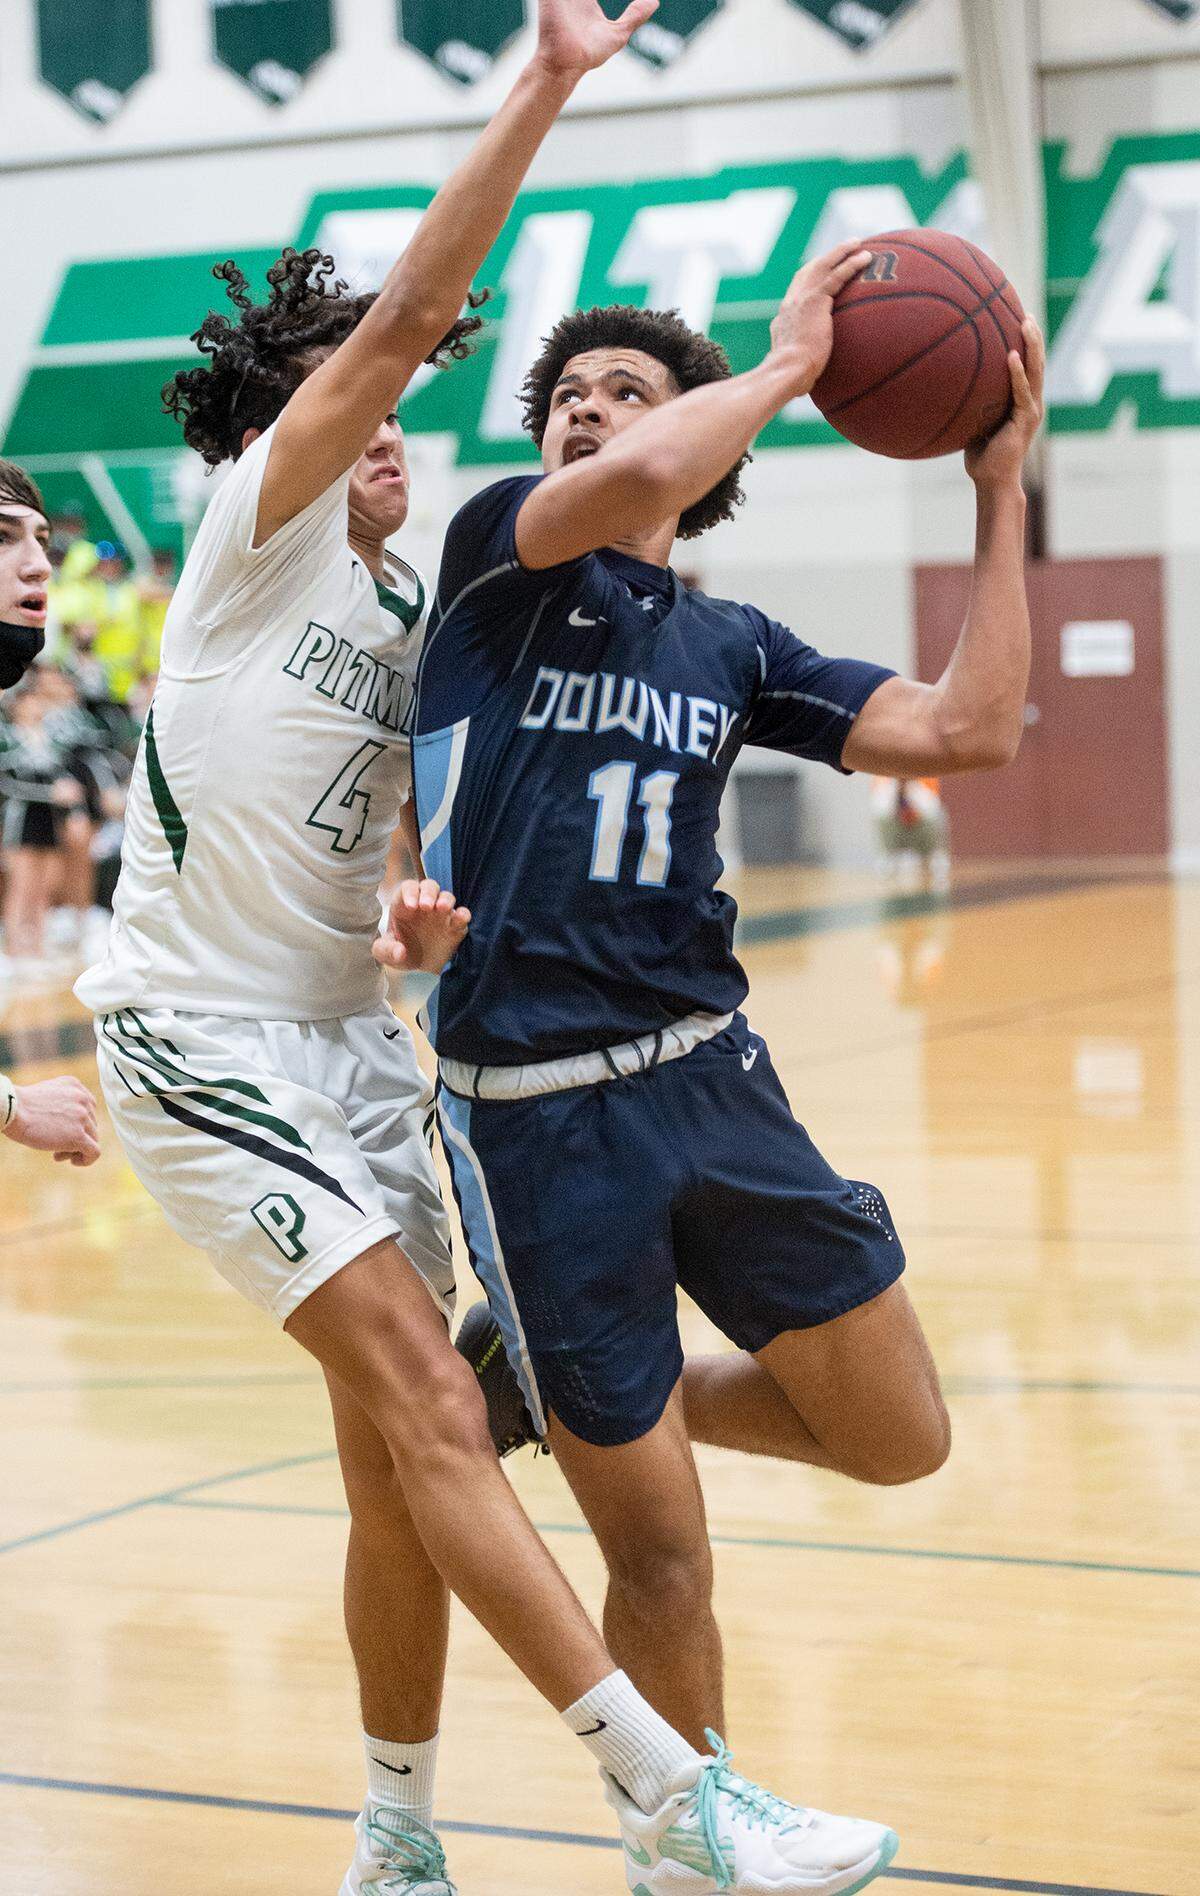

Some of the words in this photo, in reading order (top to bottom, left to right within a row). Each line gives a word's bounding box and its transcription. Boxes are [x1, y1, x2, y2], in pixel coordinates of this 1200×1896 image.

[282, 620, 417, 736] PITM
[518, 665, 739, 766] DOWNEY
[305, 738, 388, 854] 4
[587, 760, 680, 889] 11
[250, 1192, 309, 1263] P
